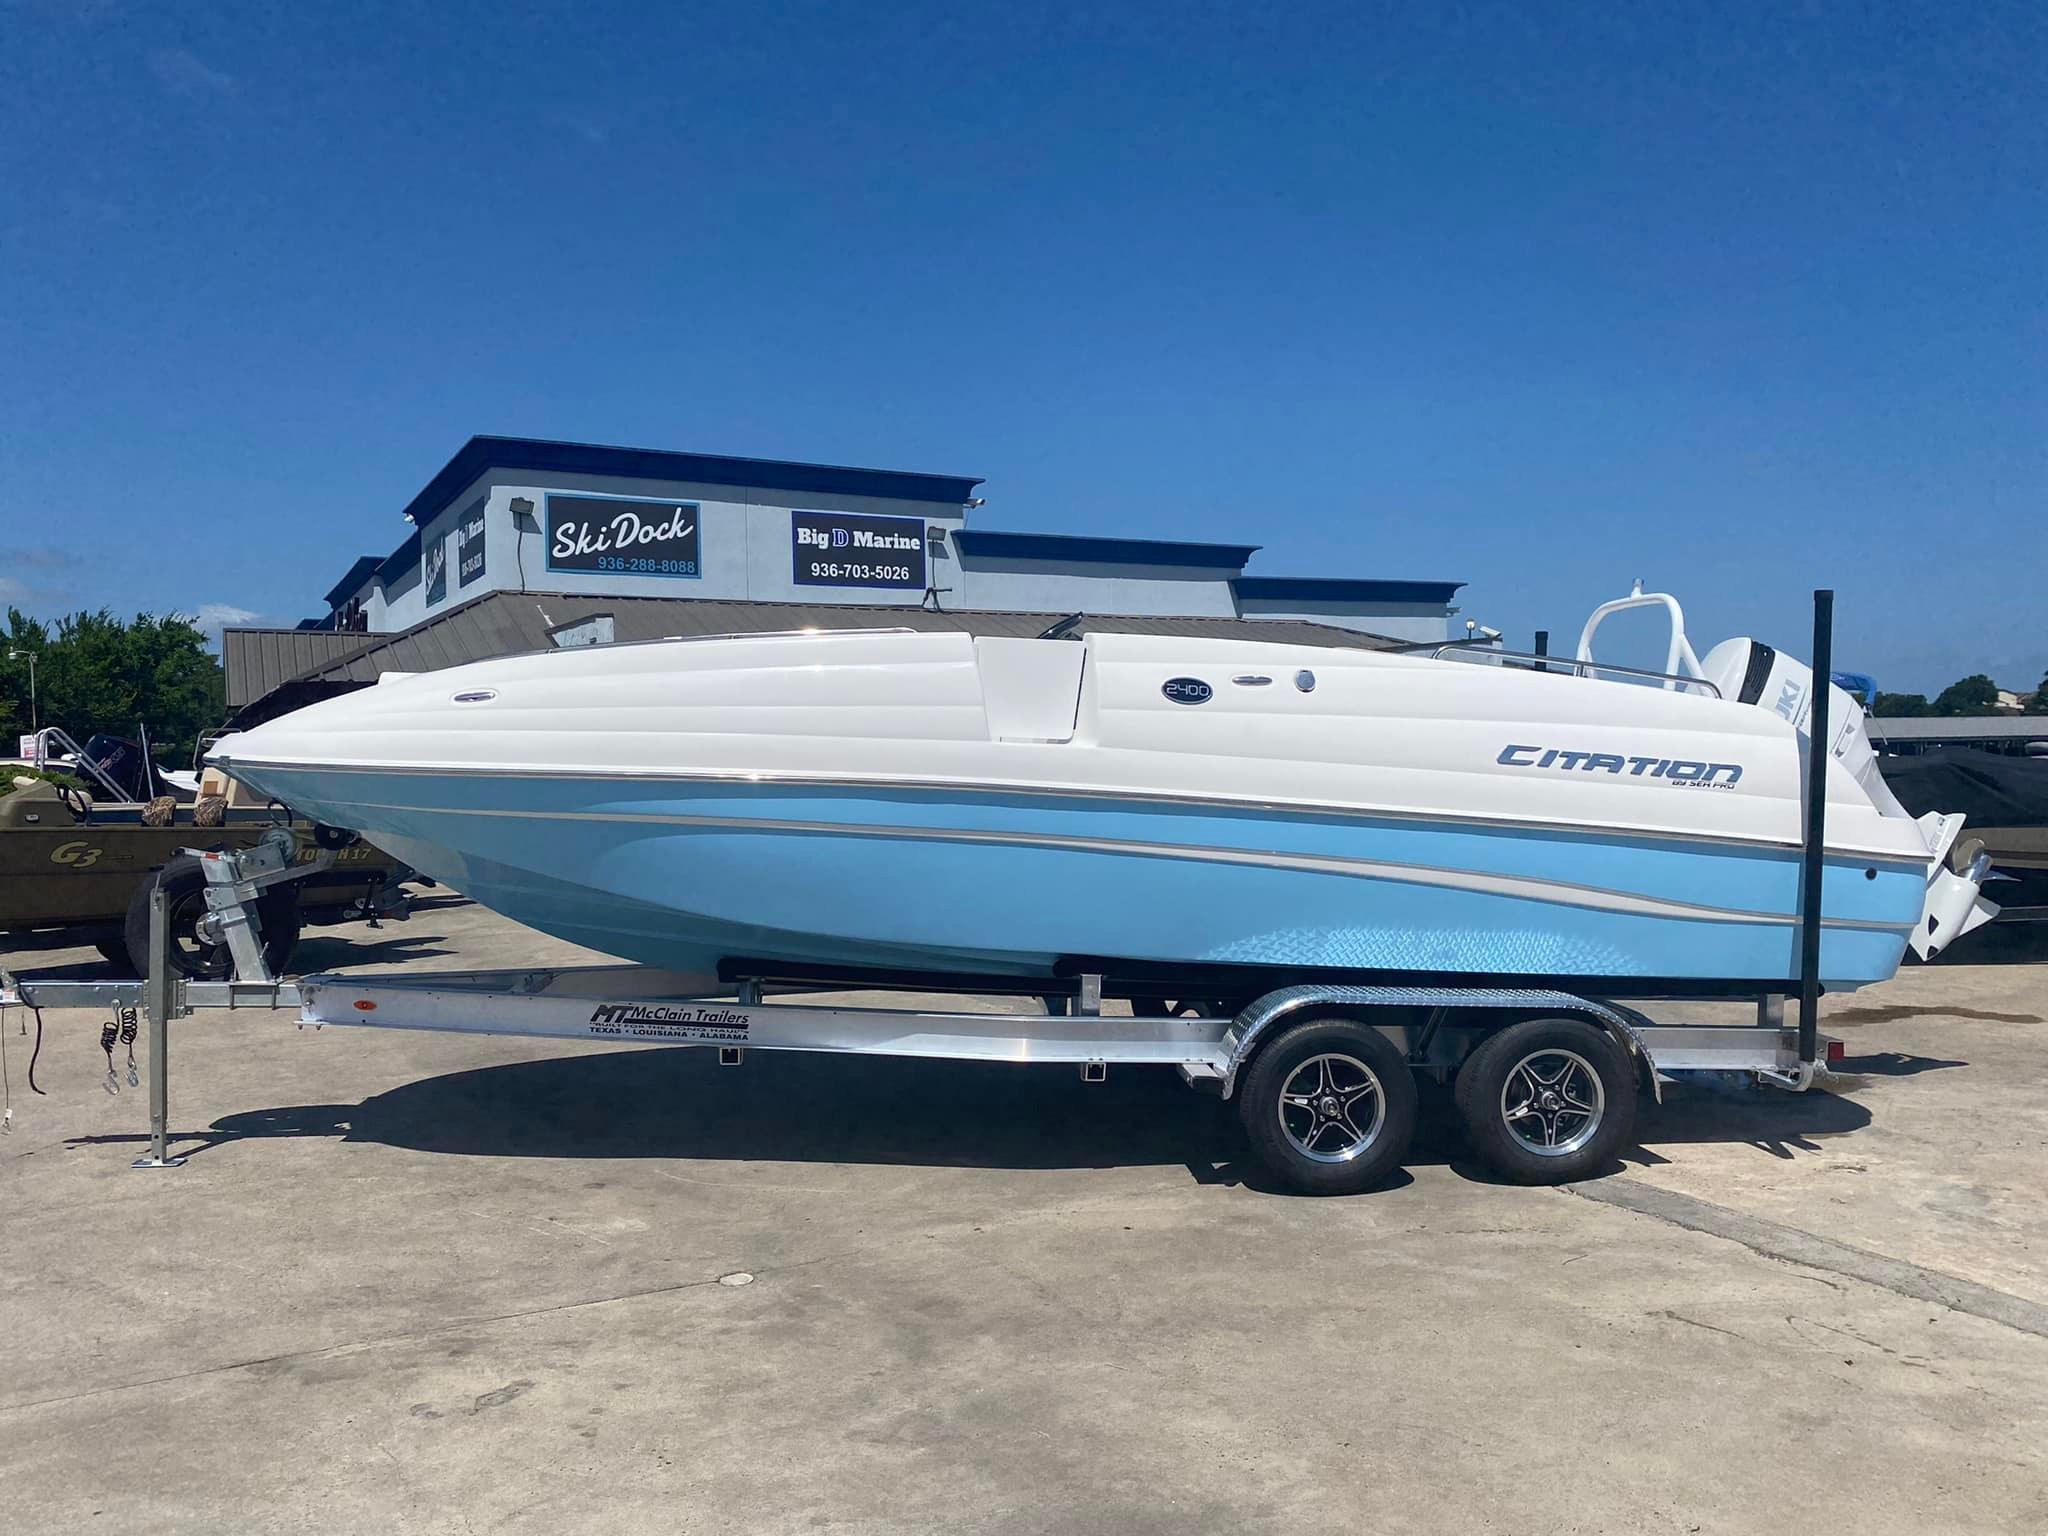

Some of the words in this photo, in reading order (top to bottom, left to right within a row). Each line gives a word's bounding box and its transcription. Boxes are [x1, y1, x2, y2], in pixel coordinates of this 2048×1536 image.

[552, 522, 611, 558] Ski
[610, 507, 694, 549] Dock
[797, 527, 829, 549] Big
[832, 528, 849, 547] D
[853, 530, 921, 550] Marine
[598, 556, 695, 573] 936-288-8088
[811, 562, 910, 580] 936-703-5026
[1166, 683, 1210, 697] 2400
[1496, 744, 1743, 783] CITATION
[50, 841, 103, 868] G3
[352, 848, 372, 860] 17
[590, 1004, 633, 1023] MT
[631, 1006, 691, 1020] McClain
[697, 1009, 750, 1024] Trailers
[589, 1026, 621, 1034] TEXAS
[633, 1029, 688, 1037] LOUISIANA
[700, 1032, 749, 1041] ALABAMA
